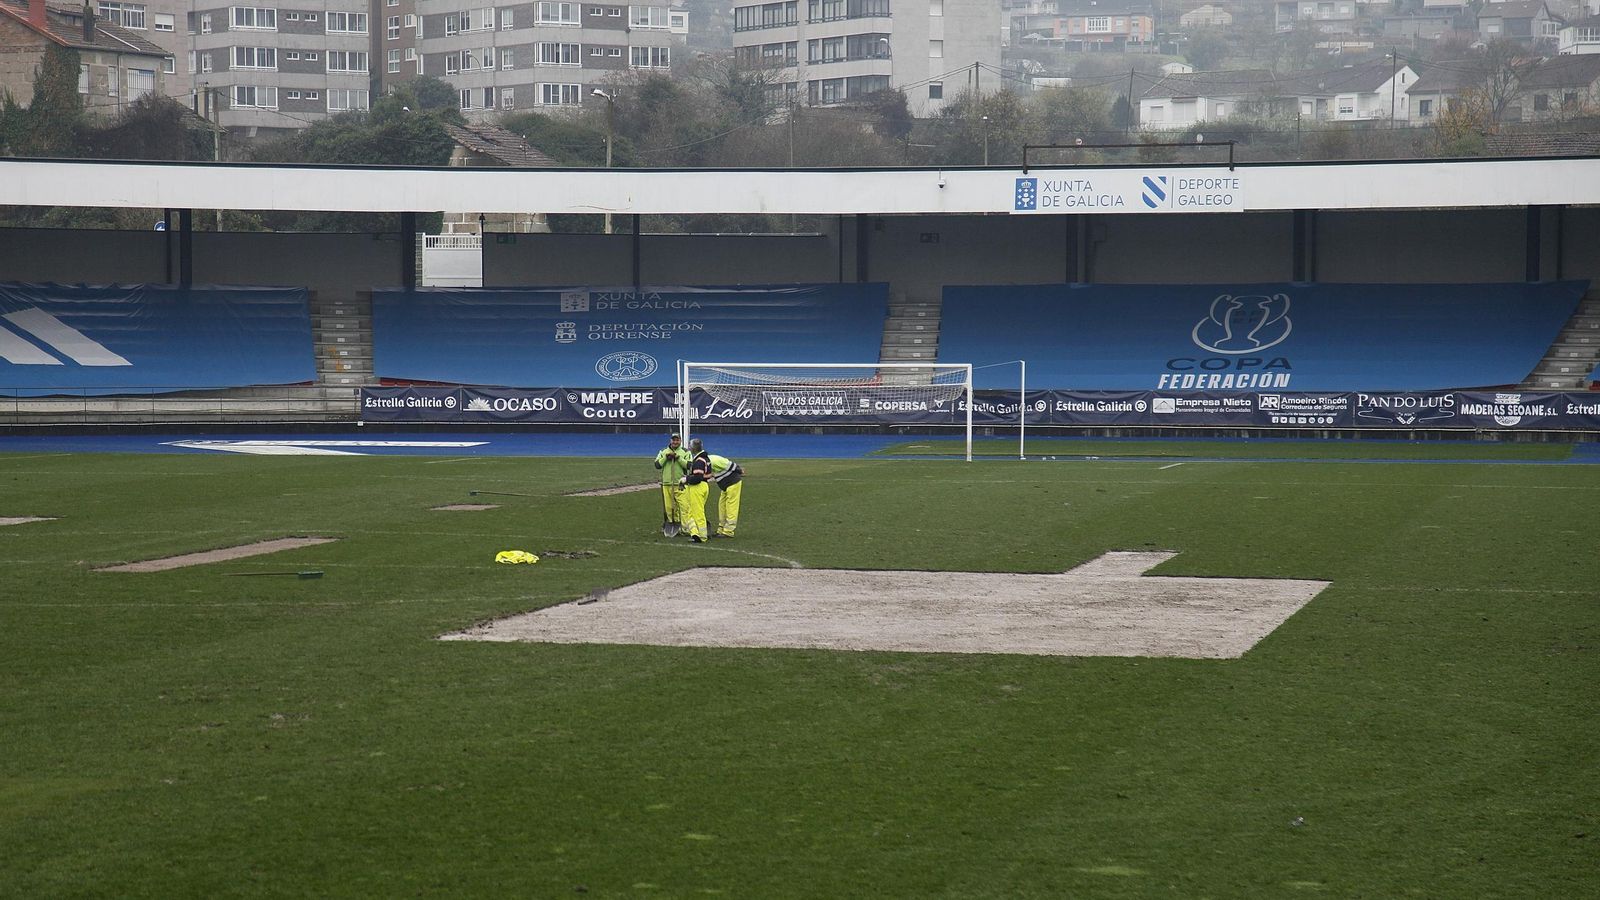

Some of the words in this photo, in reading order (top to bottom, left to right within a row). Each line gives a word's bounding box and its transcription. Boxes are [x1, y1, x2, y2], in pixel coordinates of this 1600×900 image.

[1043, 180, 1094, 192] XUNTA
[1178, 178, 1239, 190] DEPORTE
[1042, 195, 1060, 207] DE
[1065, 194, 1124, 207] GALICIA
[1178, 194, 1233, 206] GALEGO
[597, 292, 662, 300] XUNTA
[596, 302, 619, 310] DE
[626, 301, 701, 309] GALICIA
[589, 322, 704, 332] DEPUTACIÓN
[588, 332, 672, 340] OURENSE
[1166, 357, 1292, 370] COPA
[1157, 372, 1291, 390] FEDERACIÓN
[365, 396, 404, 408] Estrella
[406, 396, 442, 408] Galicia
[581, 392, 653, 404] MAPFRE
[771, 397, 806, 406] TOLDOS
[808, 396, 843, 406] GALICIA
[1176, 398, 1220, 407] Empresa
[1260, 396, 1278, 408] AR
[1357, 394, 1390, 407] PAN
[1394, 397, 1416, 408] DO
[1419, 394, 1454, 408] LUIS
[494, 397, 557, 412] OCASO
[700, 396, 753, 420] Lalo
[874, 401, 928, 411] COPERSA
[1056, 400, 1094, 412] Estrella
[1096, 400, 1132, 412] Galicia
[1460, 404, 1506, 416] MADERAS
[583, 407, 636, 418] Couto
